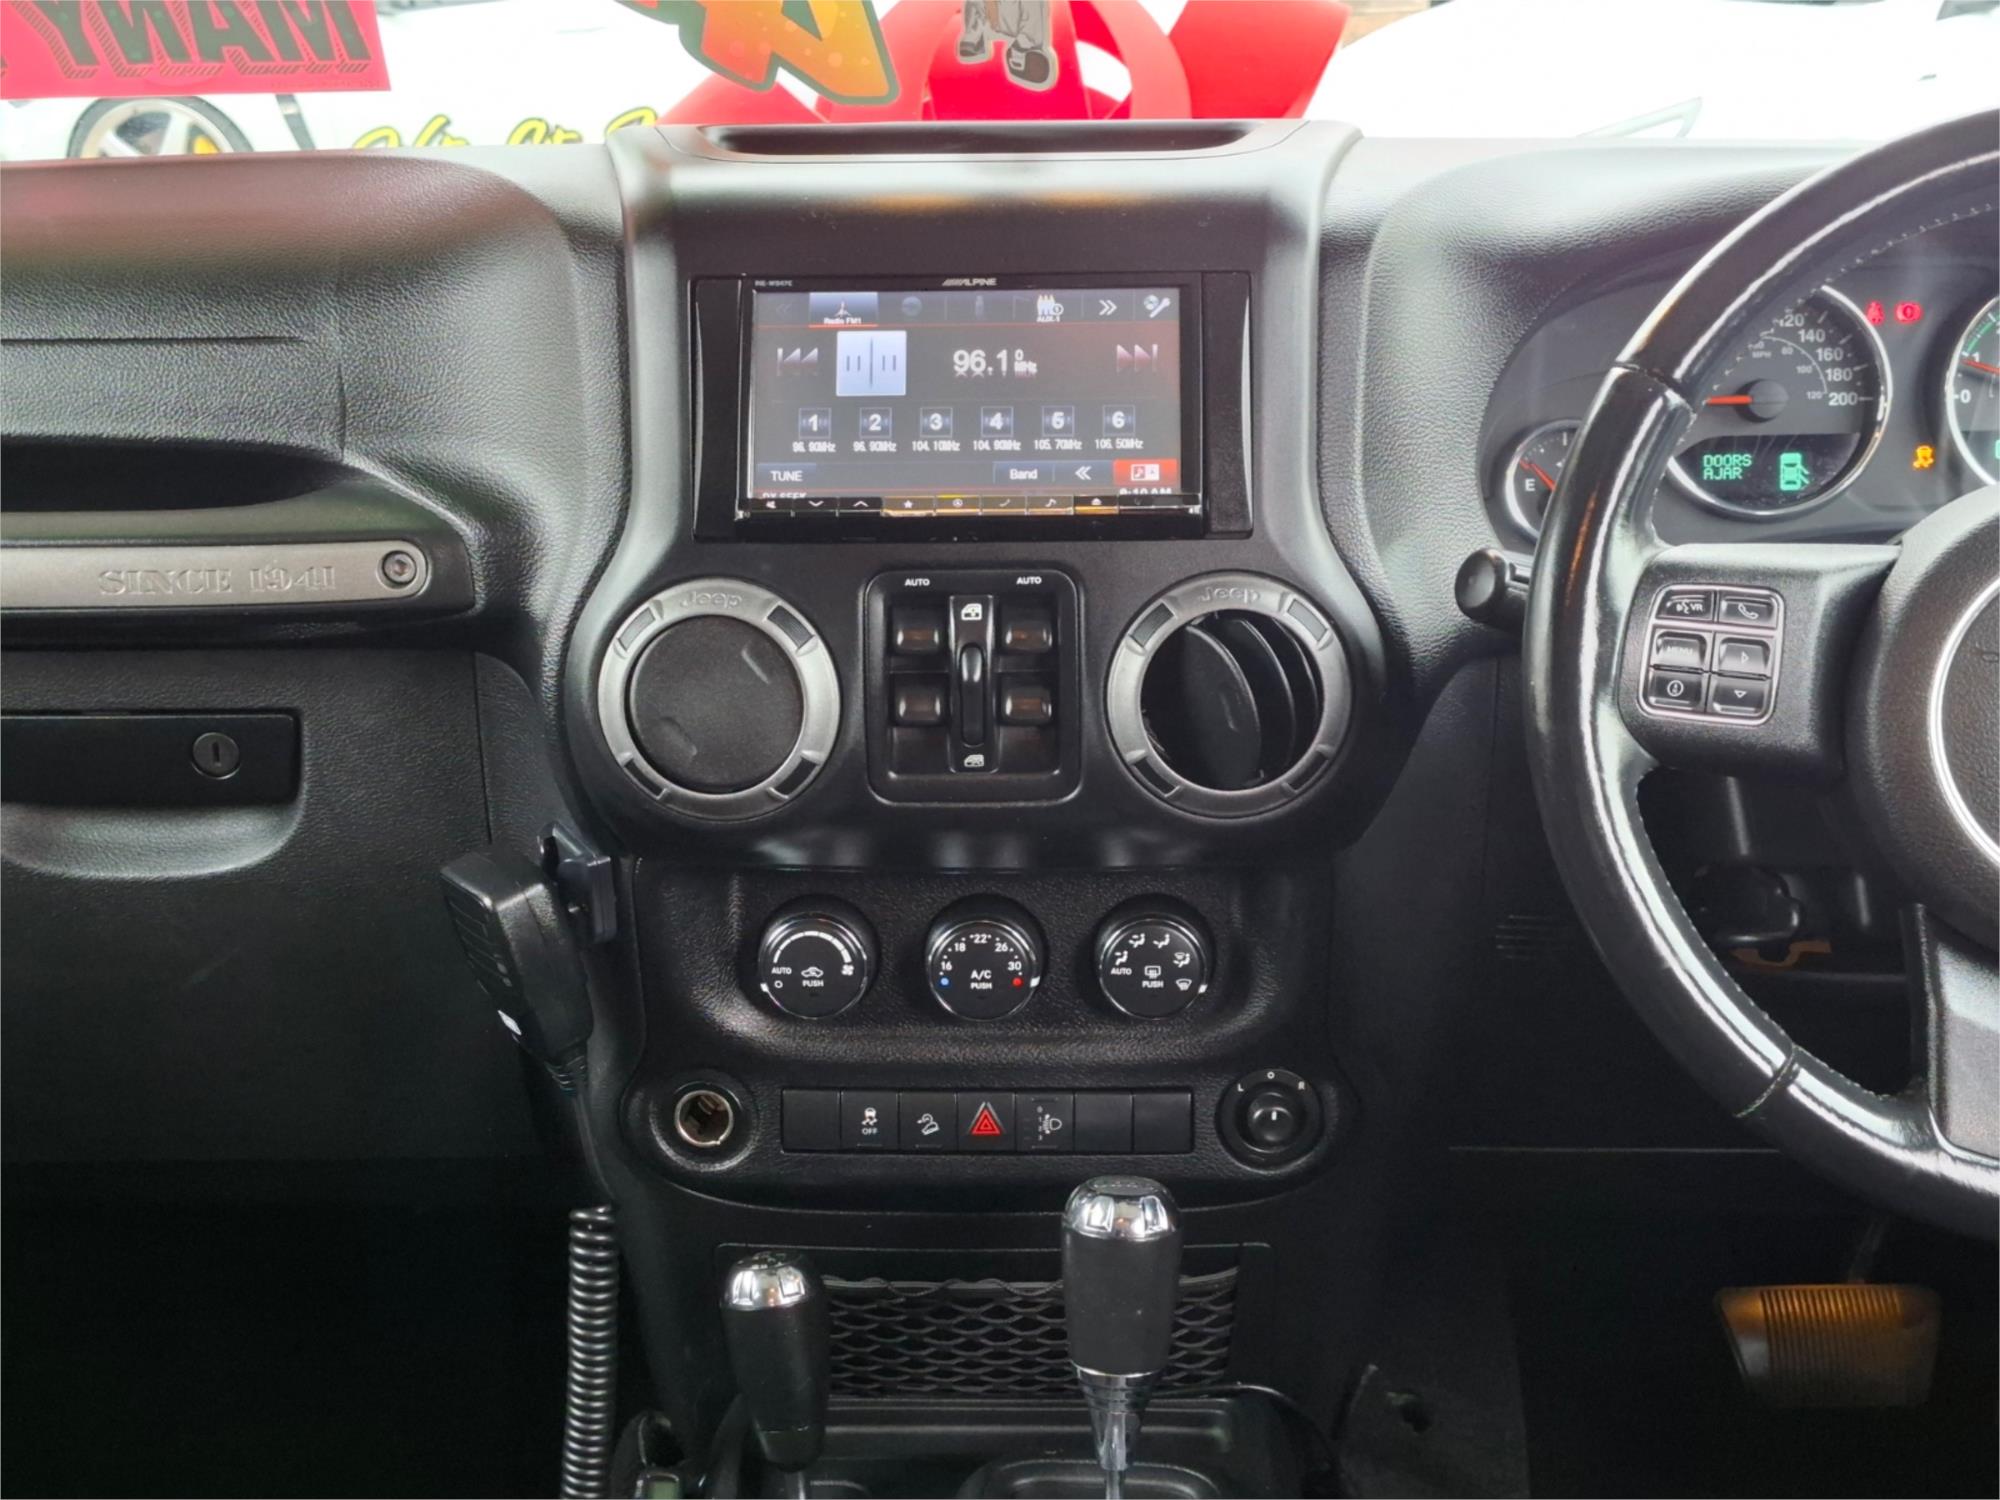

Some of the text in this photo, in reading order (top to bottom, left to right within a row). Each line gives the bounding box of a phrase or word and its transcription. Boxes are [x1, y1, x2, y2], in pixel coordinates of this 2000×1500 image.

[1797, 328, 1826, 343] 140
[1815, 347, 1844, 362] 160
[1824, 367, 1853, 382] 180
[1827, 391, 1858, 406] 200
[808, 413, 820, 432] 1
[868, 413, 882, 432] 2
[929, 412, 943, 431] 3
[989, 411, 1004, 430] 4
[1111, 410, 1125, 429] 6
[1702, 453, 1753, 468] DOORS
[769, 469, 803, 482] TUNE
[1009, 468, 1038, 480] Band
[1702, 466, 1743, 480] AJAR
[1525, 478, 1536, 492] E
[98, 564, 338, 596] SINCE 1941
[904, 577, 931, 587] AUTO
[1016, 576, 1042, 585] AUTO
[680, 590, 743, 609] Jeep
[1199, 586, 1261, 604] Jeep
[1690, 603, 1704, 612] VR
[973, 933, 988, 944] 22
[954, 942, 966, 953] 18
[995, 942, 1009, 953] 26
[771, 966, 792, 975] AUTO
[941, 961, 953, 971] 16
[1007, 961, 1022, 971] 30
[1111, 967, 1132, 975] AUTO
[970, 969, 992, 980] A/C
[802, 979, 825, 988] PUSH
[970, 981, 993, 990] PUSH
[1142, 980, 1164, 989] PUSH
[1237, 1083, 1245, 1092] L
[861, 1127, 878, 1136] OFF
